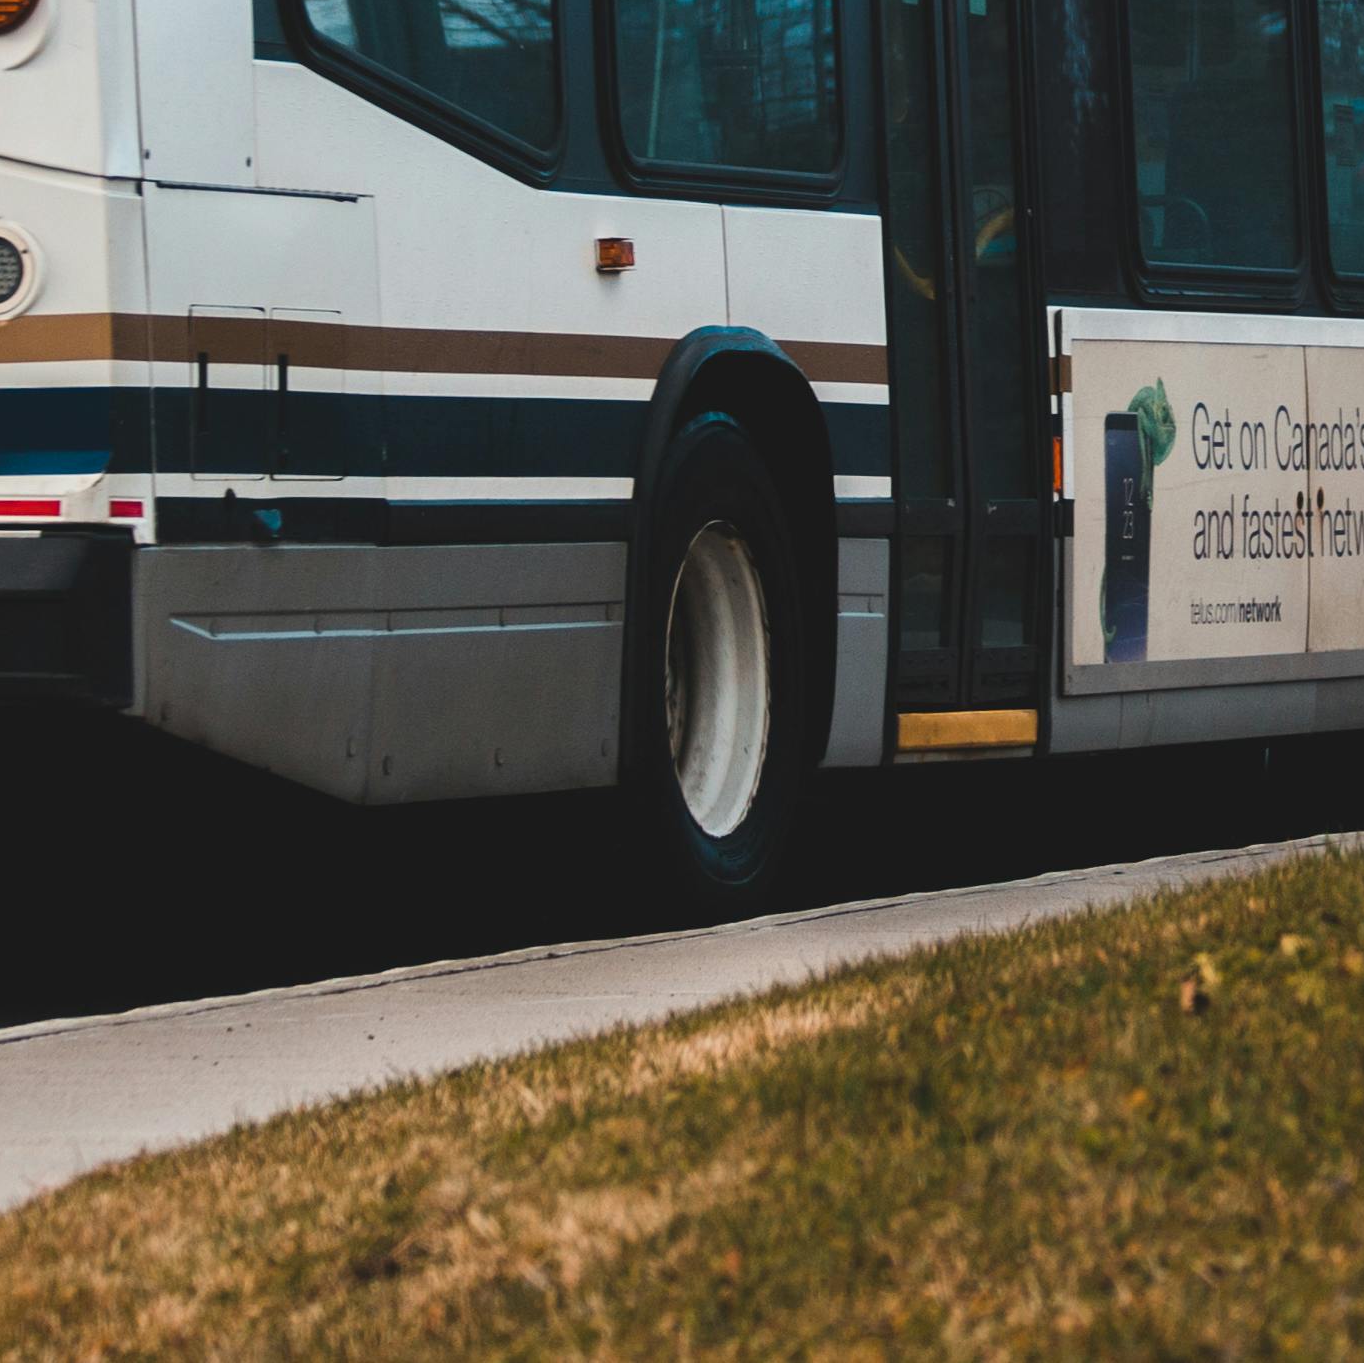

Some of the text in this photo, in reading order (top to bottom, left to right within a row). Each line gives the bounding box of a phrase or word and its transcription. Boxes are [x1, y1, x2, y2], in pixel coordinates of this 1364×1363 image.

[1191, 402, 1233, 471] Get
[1240, 421, 1268, 470] on
[1193, 494, 1235, 560] and
[1241, 494, 1314, 560] fastest
